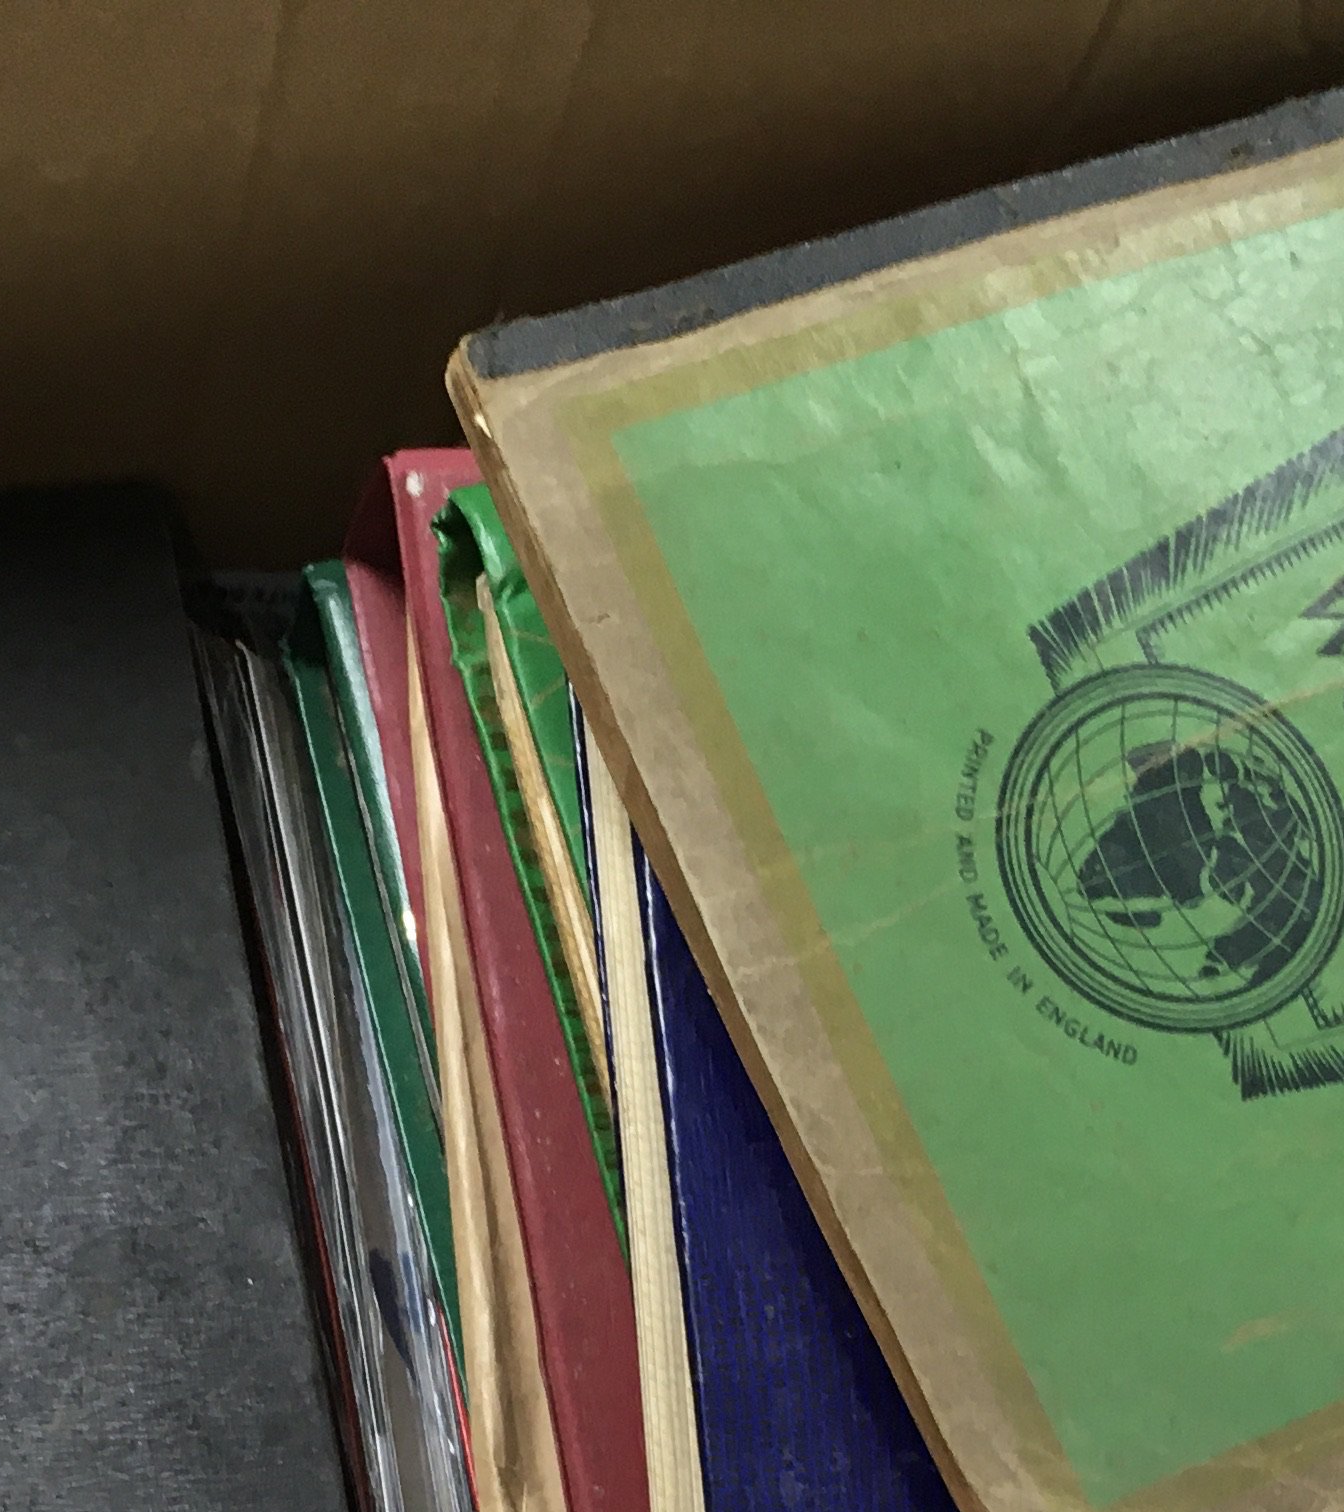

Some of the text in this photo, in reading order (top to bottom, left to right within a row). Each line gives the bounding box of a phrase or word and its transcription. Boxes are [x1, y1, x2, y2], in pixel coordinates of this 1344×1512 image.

[955, 727, 1138, 1066] PRINTED AND MADE IN ENGLAND
